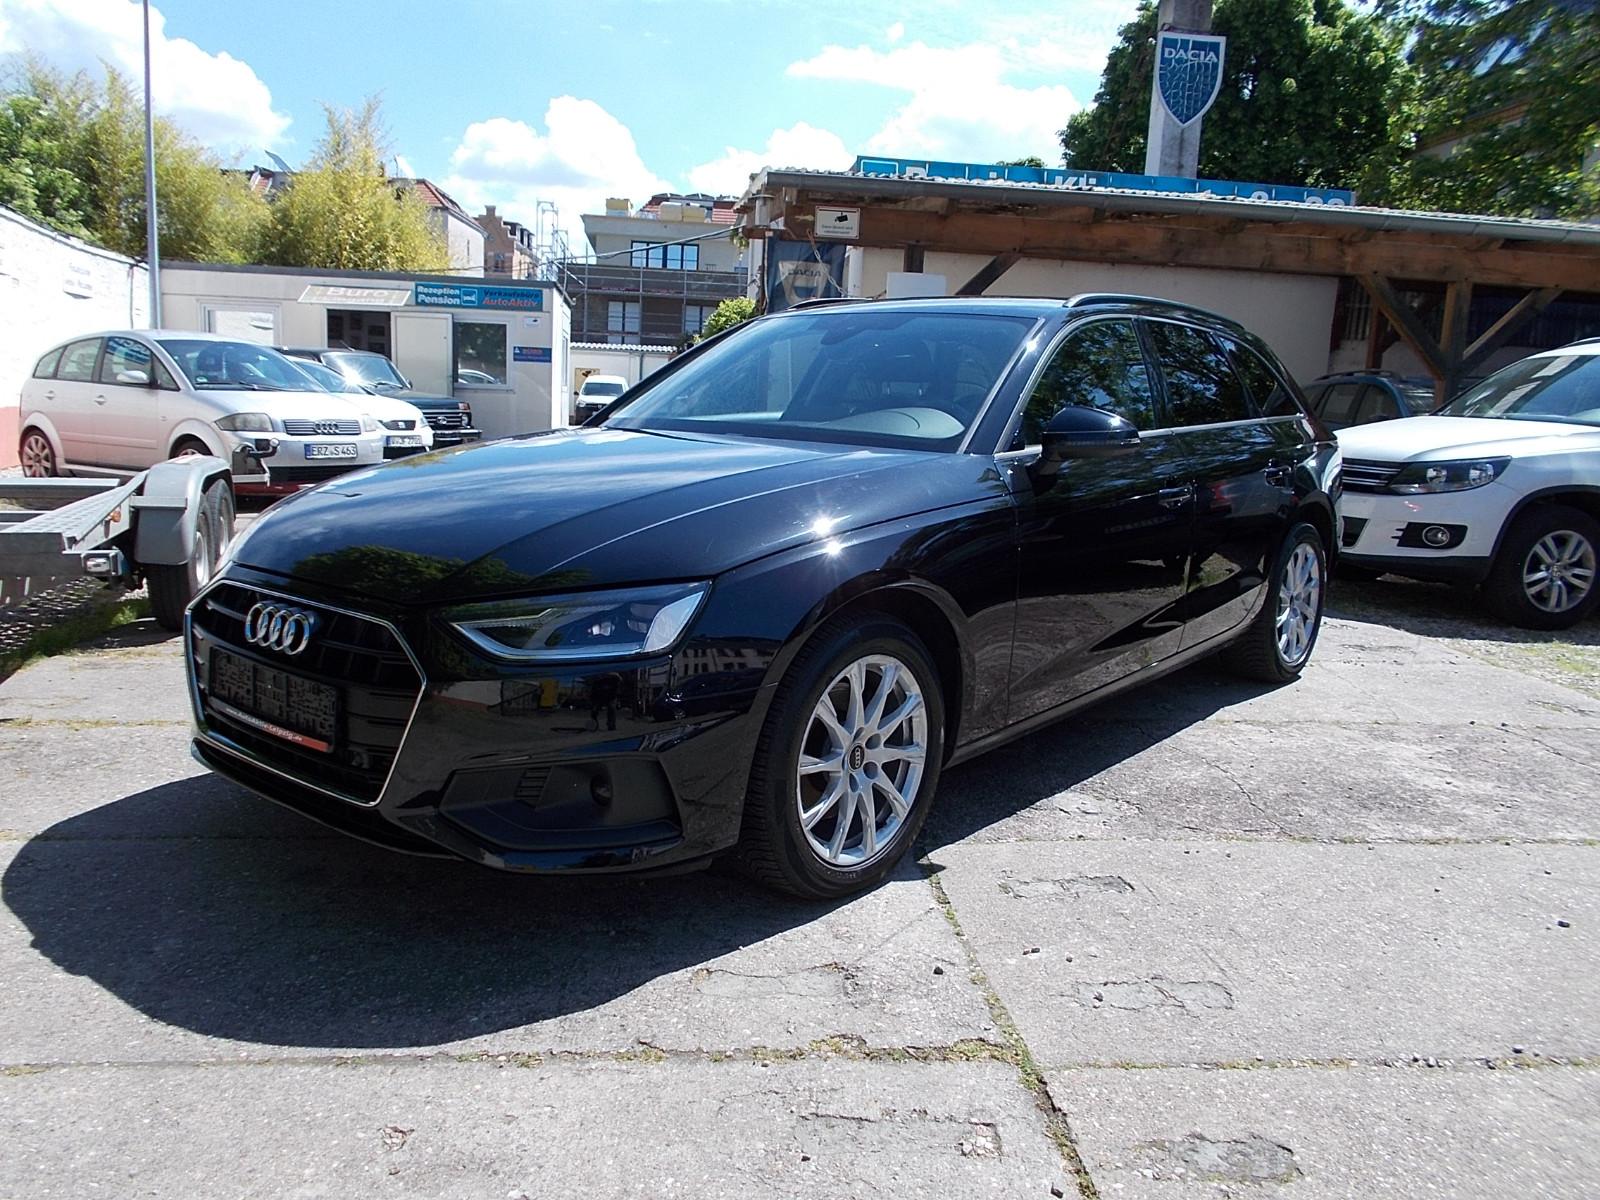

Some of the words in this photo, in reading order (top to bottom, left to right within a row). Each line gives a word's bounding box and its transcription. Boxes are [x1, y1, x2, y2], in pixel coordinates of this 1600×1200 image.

[1164, 48, 1218, 63] DACIA
[417, 286, 460, 296] Rezeption
[418, 294, 461, 305] Pension
[482, 297, 538, 307] AutoAktiv
[311, 446, 329, 456] ERZ
[334, 446, 340, 456] S
